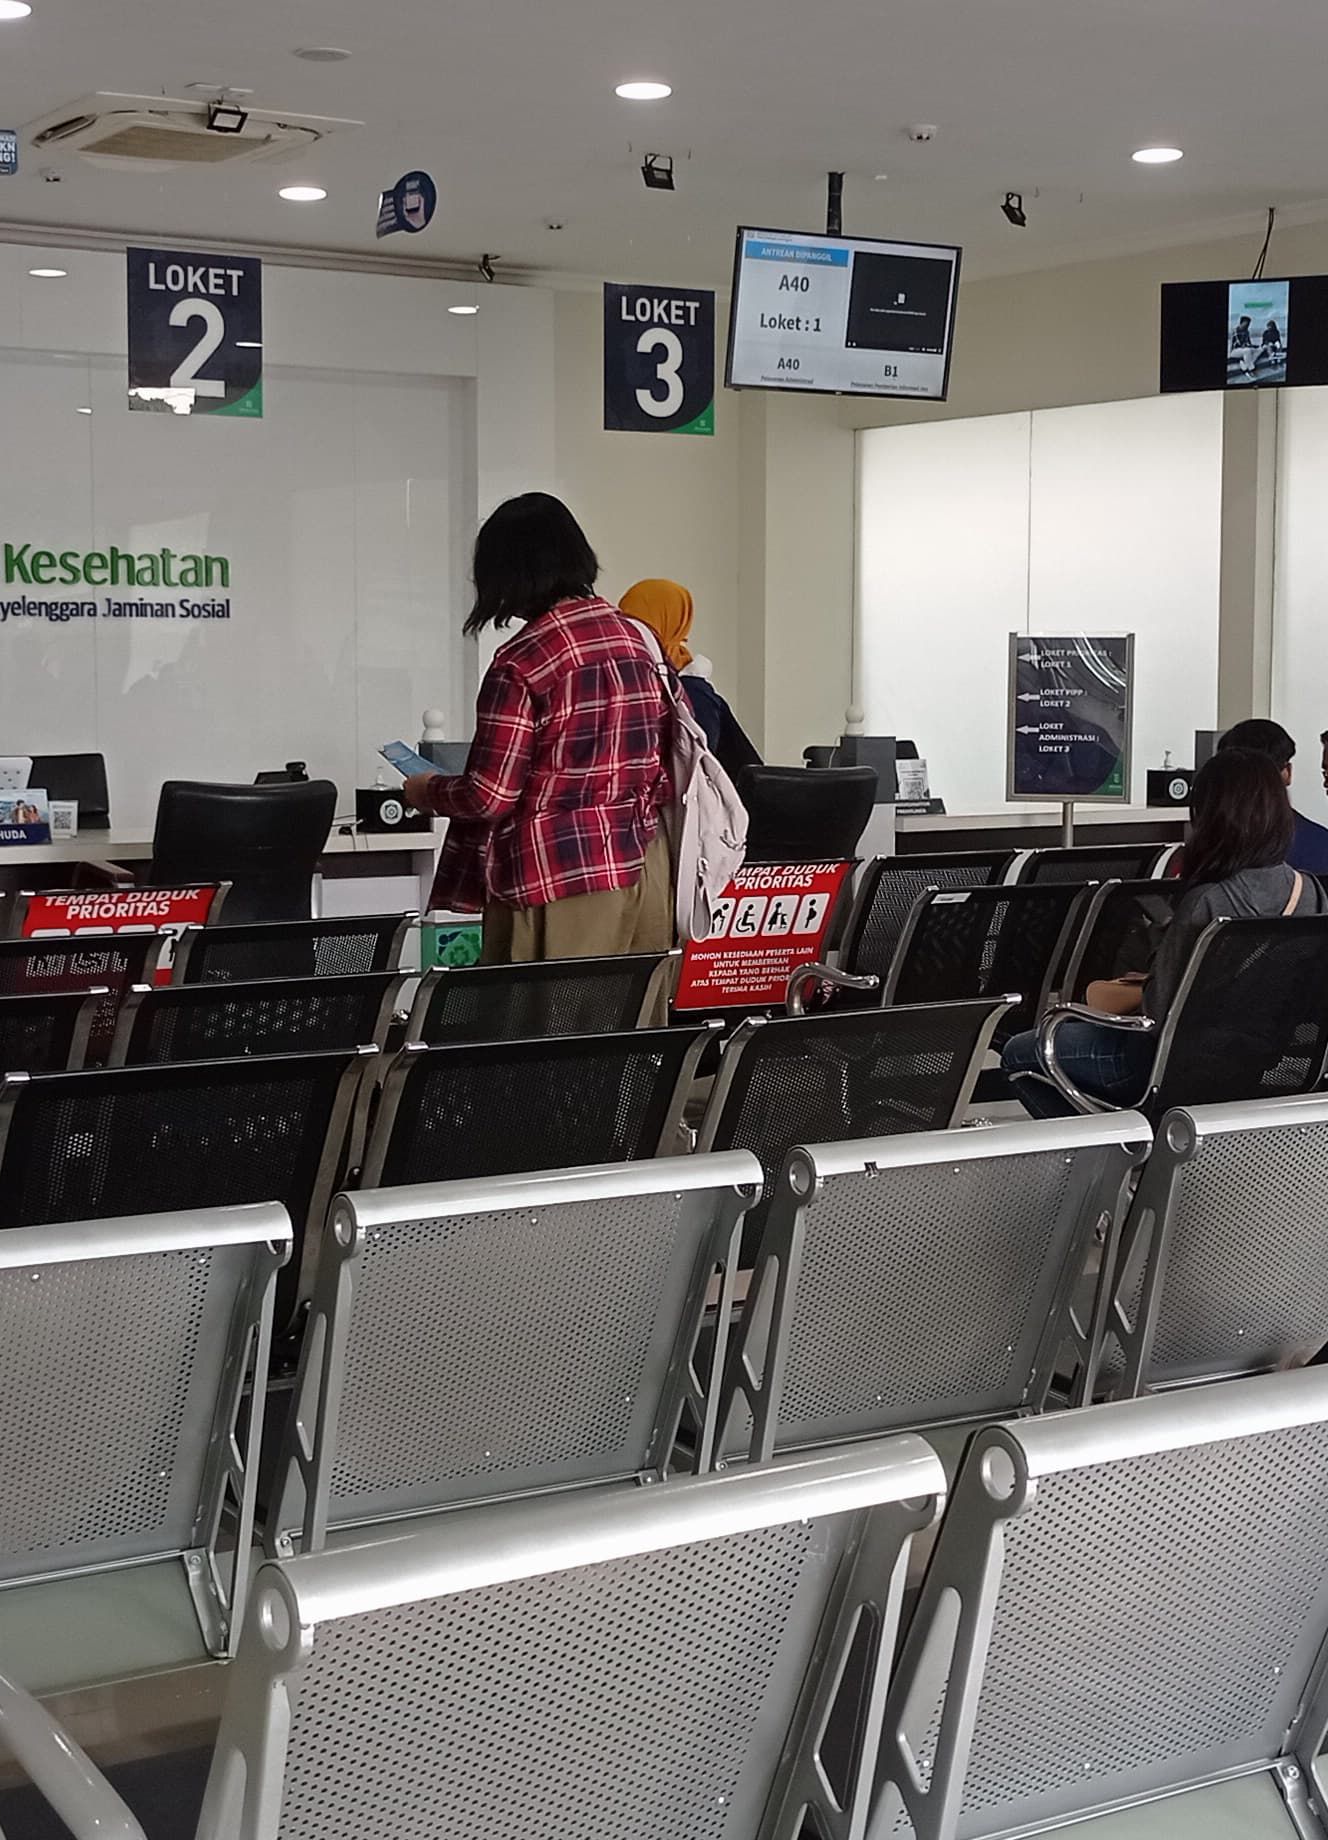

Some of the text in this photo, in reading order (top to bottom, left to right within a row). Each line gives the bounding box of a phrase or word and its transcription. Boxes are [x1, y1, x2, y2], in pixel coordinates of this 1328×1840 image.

[148, 263, 244, 296] LOKET
[779, 275, 809, 292] A40
[622, 296, 700, 325] LOKET
[760, 313, 801, 331] Loket
[813, 318, 821, 332] 1
[169, 298, 225, 398] 2
[635, 327, 684, 418] 3
[777, 358, 800, 371] A40
[884, 365, 898, 378] B1
[3, 543, 230, 587] Kesehatan
[102, 598, 176, 618] Jaminan
[179, 598, 230, 619] Sosial
[782, 864, 840, 875] DUDUK
[735, 875, 814, 890] PRIORITAS
[45, 889, 201, 907] TEMPAT DUDUK
[67, 901, 170, 920] PRIORITAS
[691, 953, 722, 961] MOHON
[796, 947, 814, 955] LAIN
[709, 970, 737, 978] KEPADA
[712, 978, 739, 986] TEMPAT
[740, 976, 767, 984] DUDUK
